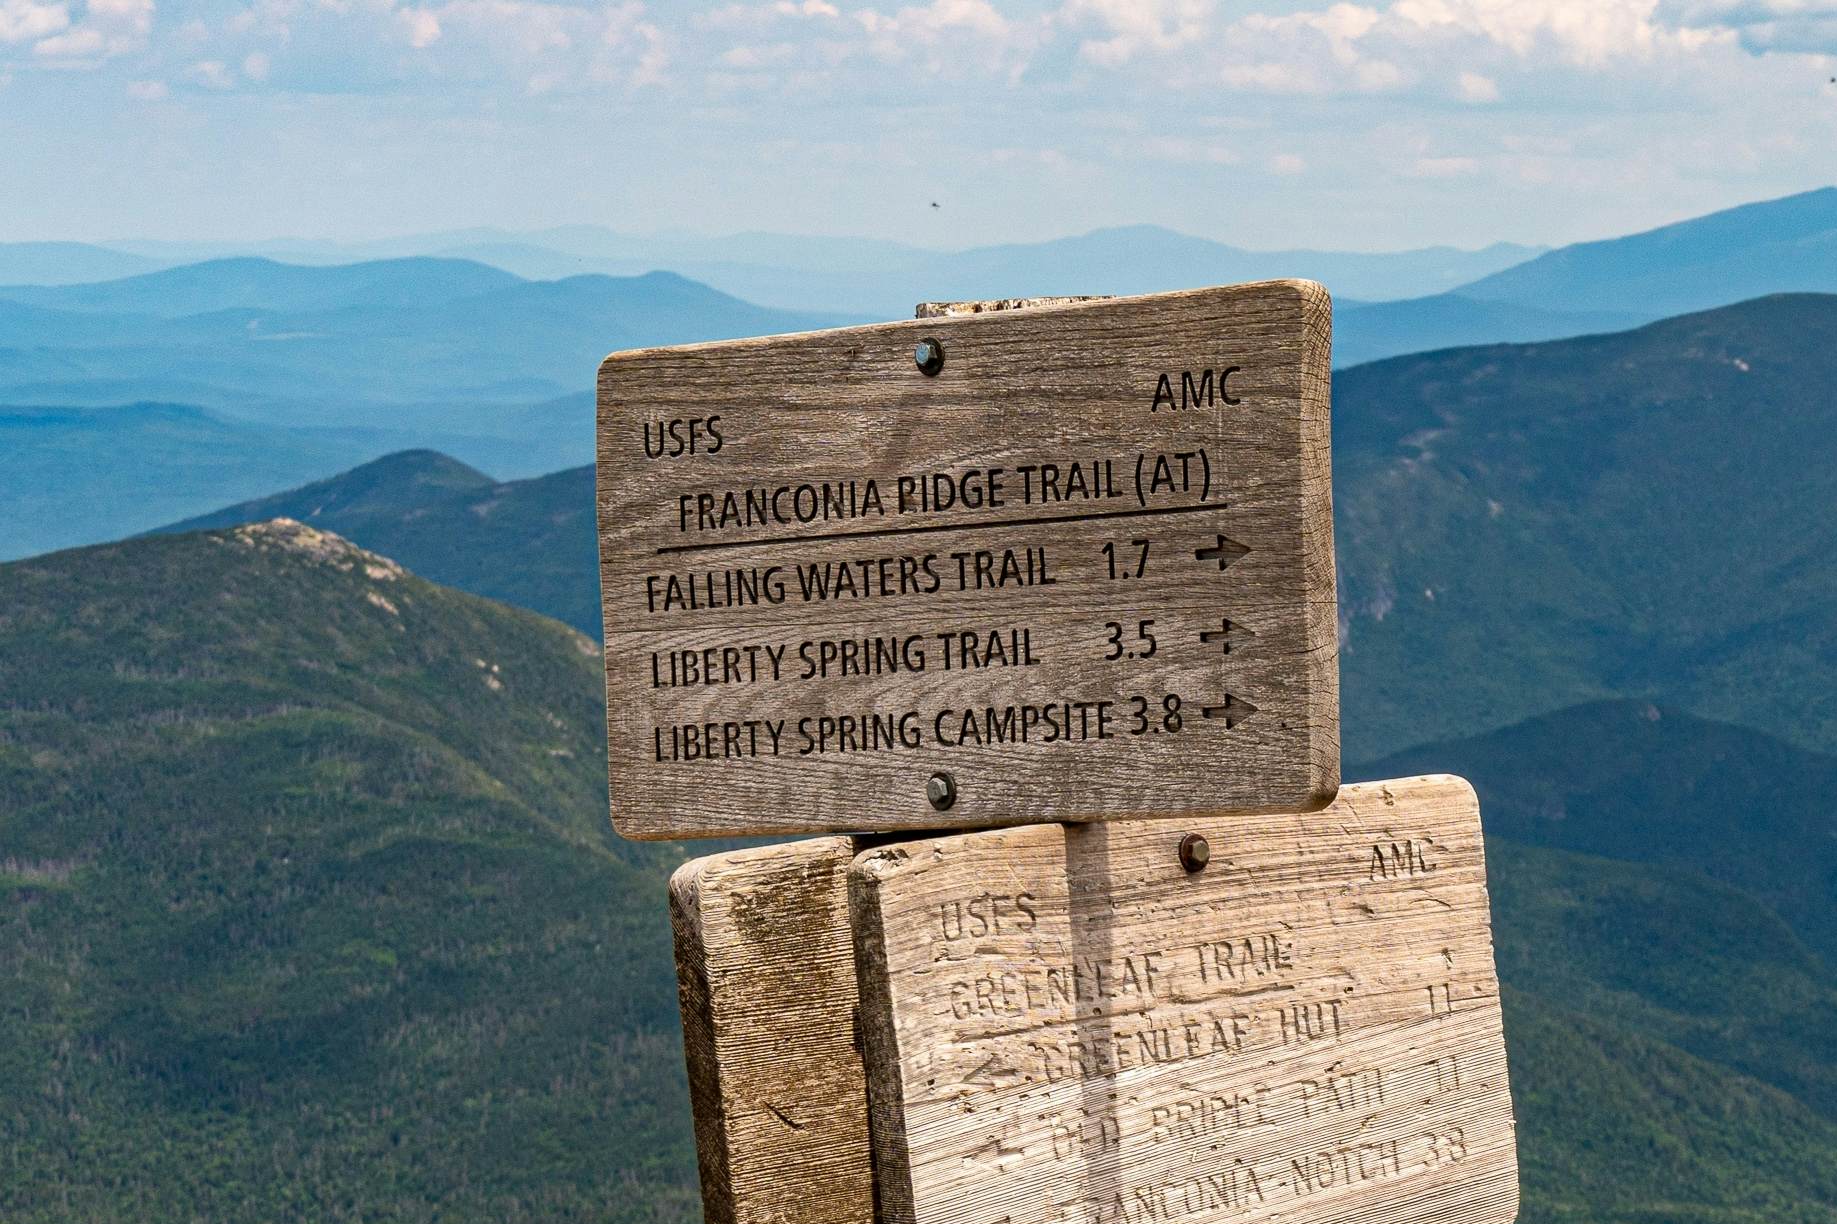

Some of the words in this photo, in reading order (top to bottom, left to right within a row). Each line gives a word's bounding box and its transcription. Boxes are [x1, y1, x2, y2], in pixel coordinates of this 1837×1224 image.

[1151, 366, 1241, 412] AMC
[643, 415, 723, 459] USFS
[679, 479, 885, 532] FRANCONIA
[897, 469, 1005, 517] RIDGE
[1016, 459, 1123, 505] TRAIL
[1135, 448, 1210, 507] (AT)
[647, 566, 785, 612] FALLING
[797, 554, 940, 601] WATERS
[951, 546, 1056, 591] TRAIL
[1101, 539, 1149, 580] 1.7
[652, 644, 786, 688] LIBERTY
[800, 635, 925, 679] SPRING
[937, 628, 1040, 670] TRAIL
[1105, 620, 1157, 661] 3.5
[655, 719, 785, 762] LIBERTY
[799, 711, 921, 755] SPRING
[934, 701, 1114, 747] CAMPSITE
[1130, 694, 1183, 735] 3.8
[1368, 837, 1437, 881] AMC
[940, 892, 1038, 942] USFS
[950, 950, 1162, 1020] GREENLEAF
[1292, 1138, 1400, 1197] NOTCH
